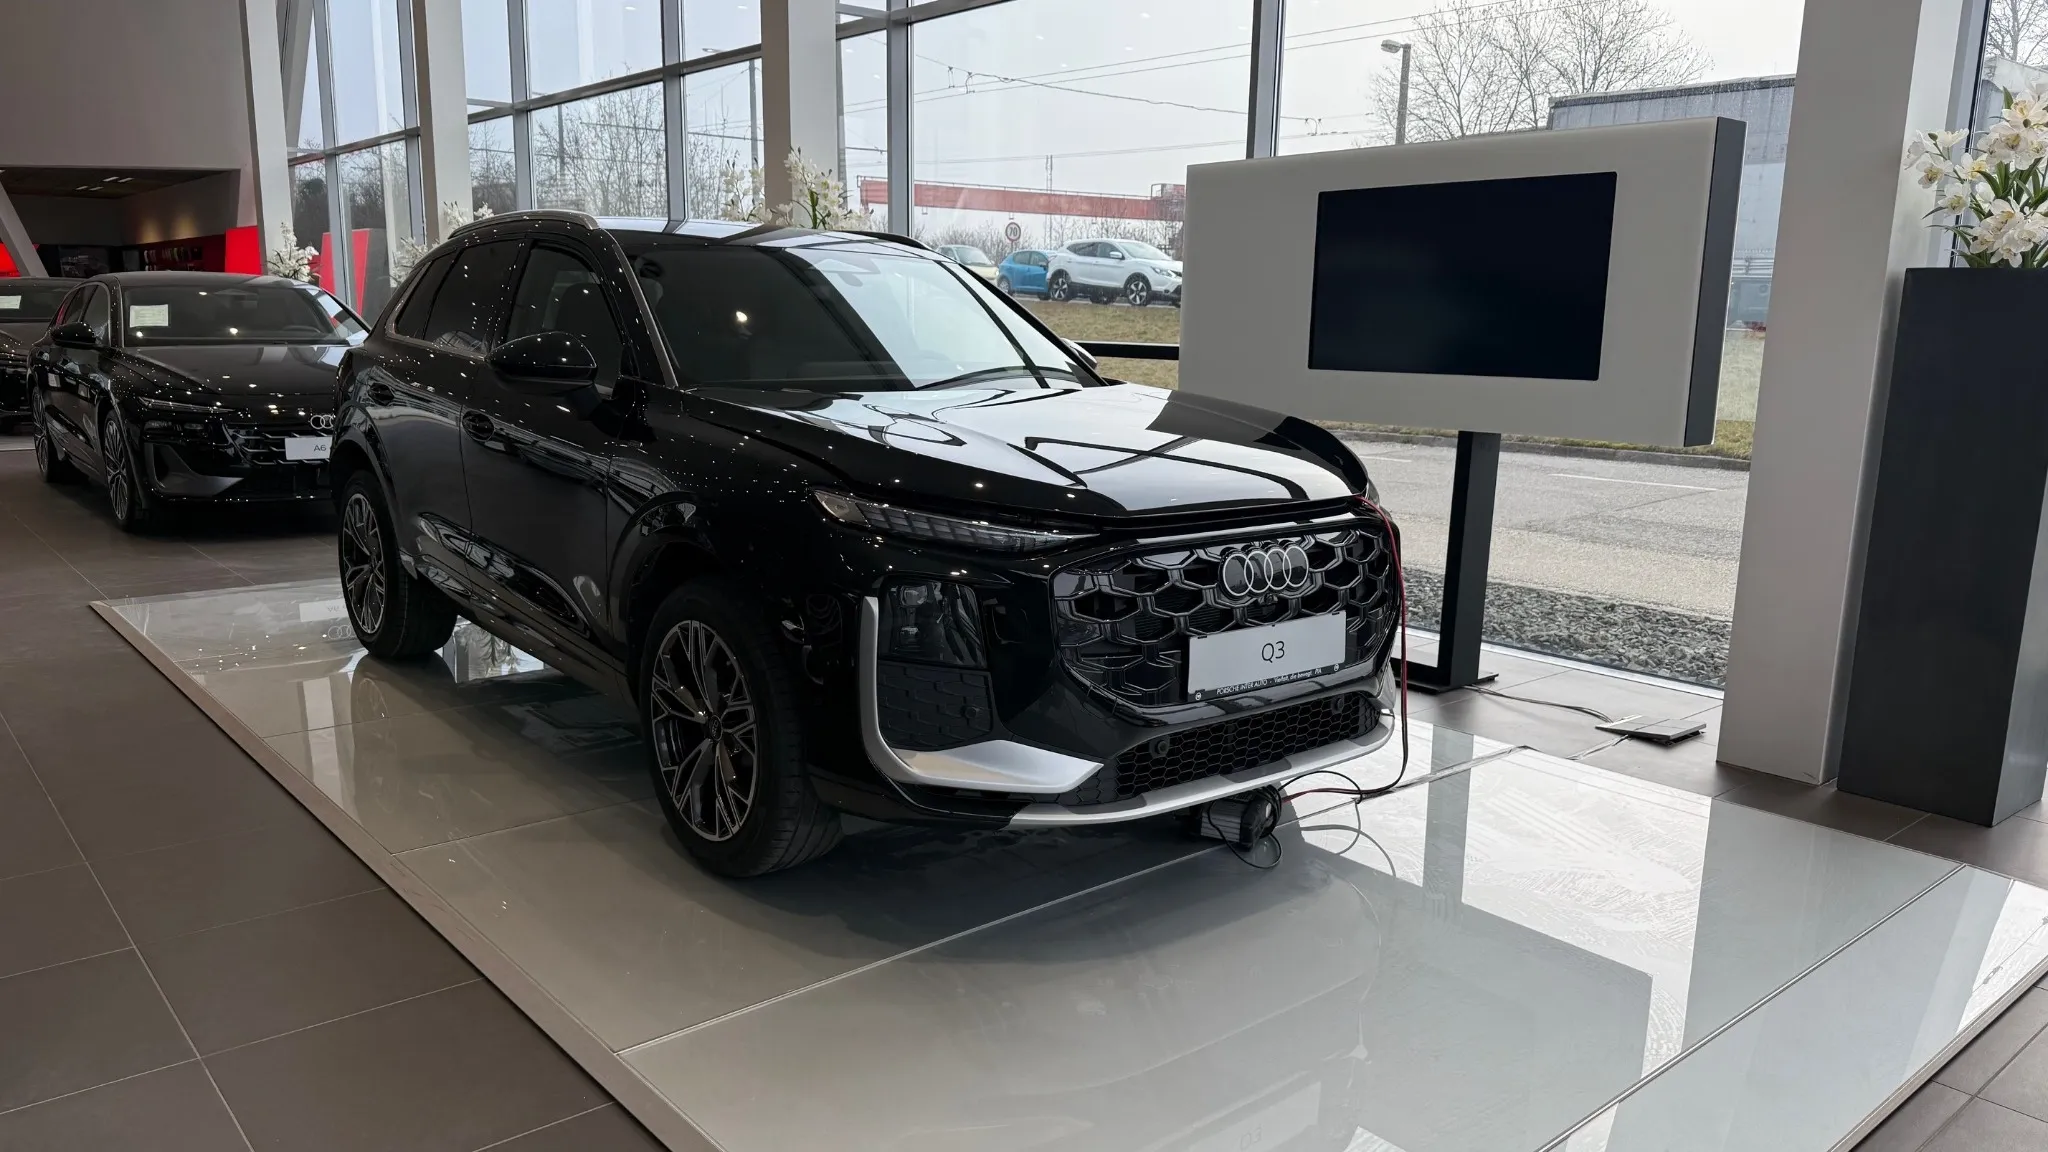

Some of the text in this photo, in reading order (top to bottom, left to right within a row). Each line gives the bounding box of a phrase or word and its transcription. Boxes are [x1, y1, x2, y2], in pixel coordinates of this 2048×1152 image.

[1009, 227, 1018, 236] 70
[1261, 640, 1285, 663] Q3
[1216, 685, 1240, 695] PORSCHE
[1240, 682, 1254, 691] INTER
[1254, 679, 1268, 688] AUTO
